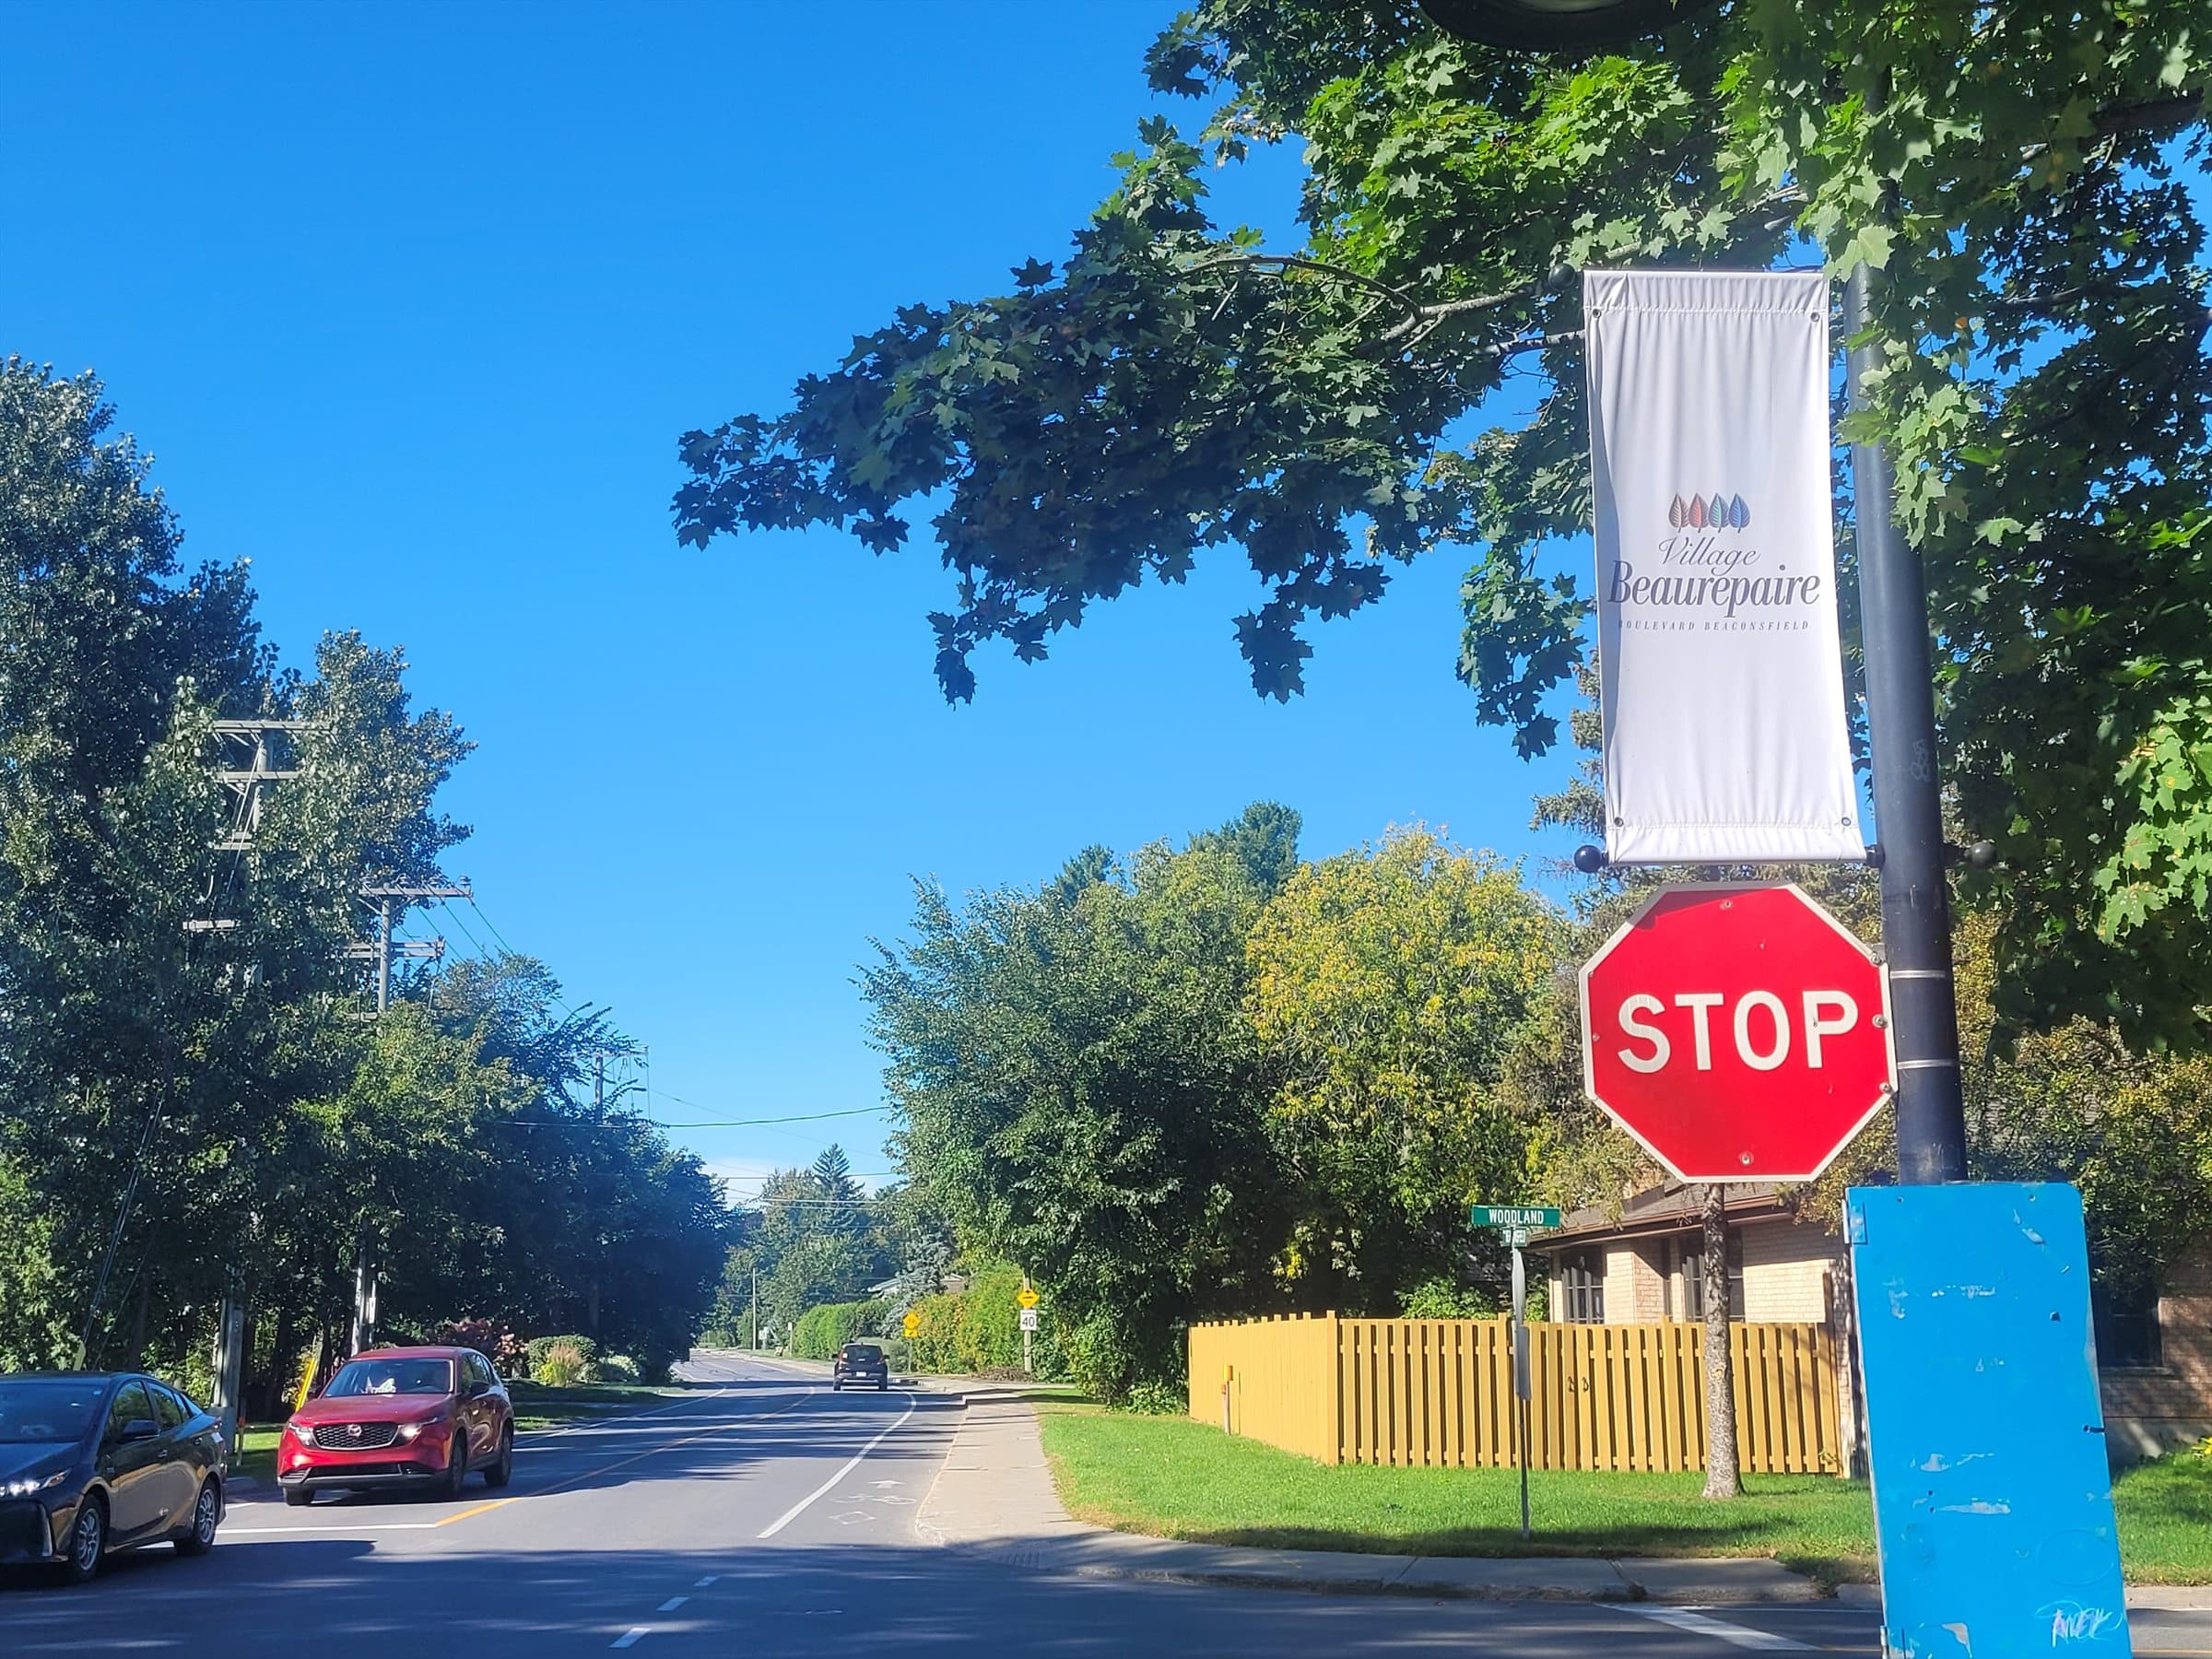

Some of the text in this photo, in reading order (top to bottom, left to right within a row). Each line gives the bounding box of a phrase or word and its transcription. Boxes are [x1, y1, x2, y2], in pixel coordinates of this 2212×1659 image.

[1658, 536, 1759, 576] Village
[1607, 560, 1820, 618] Beaurepaire
[1704, 621, 1808, 631] BEACONSFIELD
[1618, 991, 1858, 1073] STOP
[1488, 1209, 1544, 1224] WOODLAND
[1022, 1317, 1035, 1327] 40
